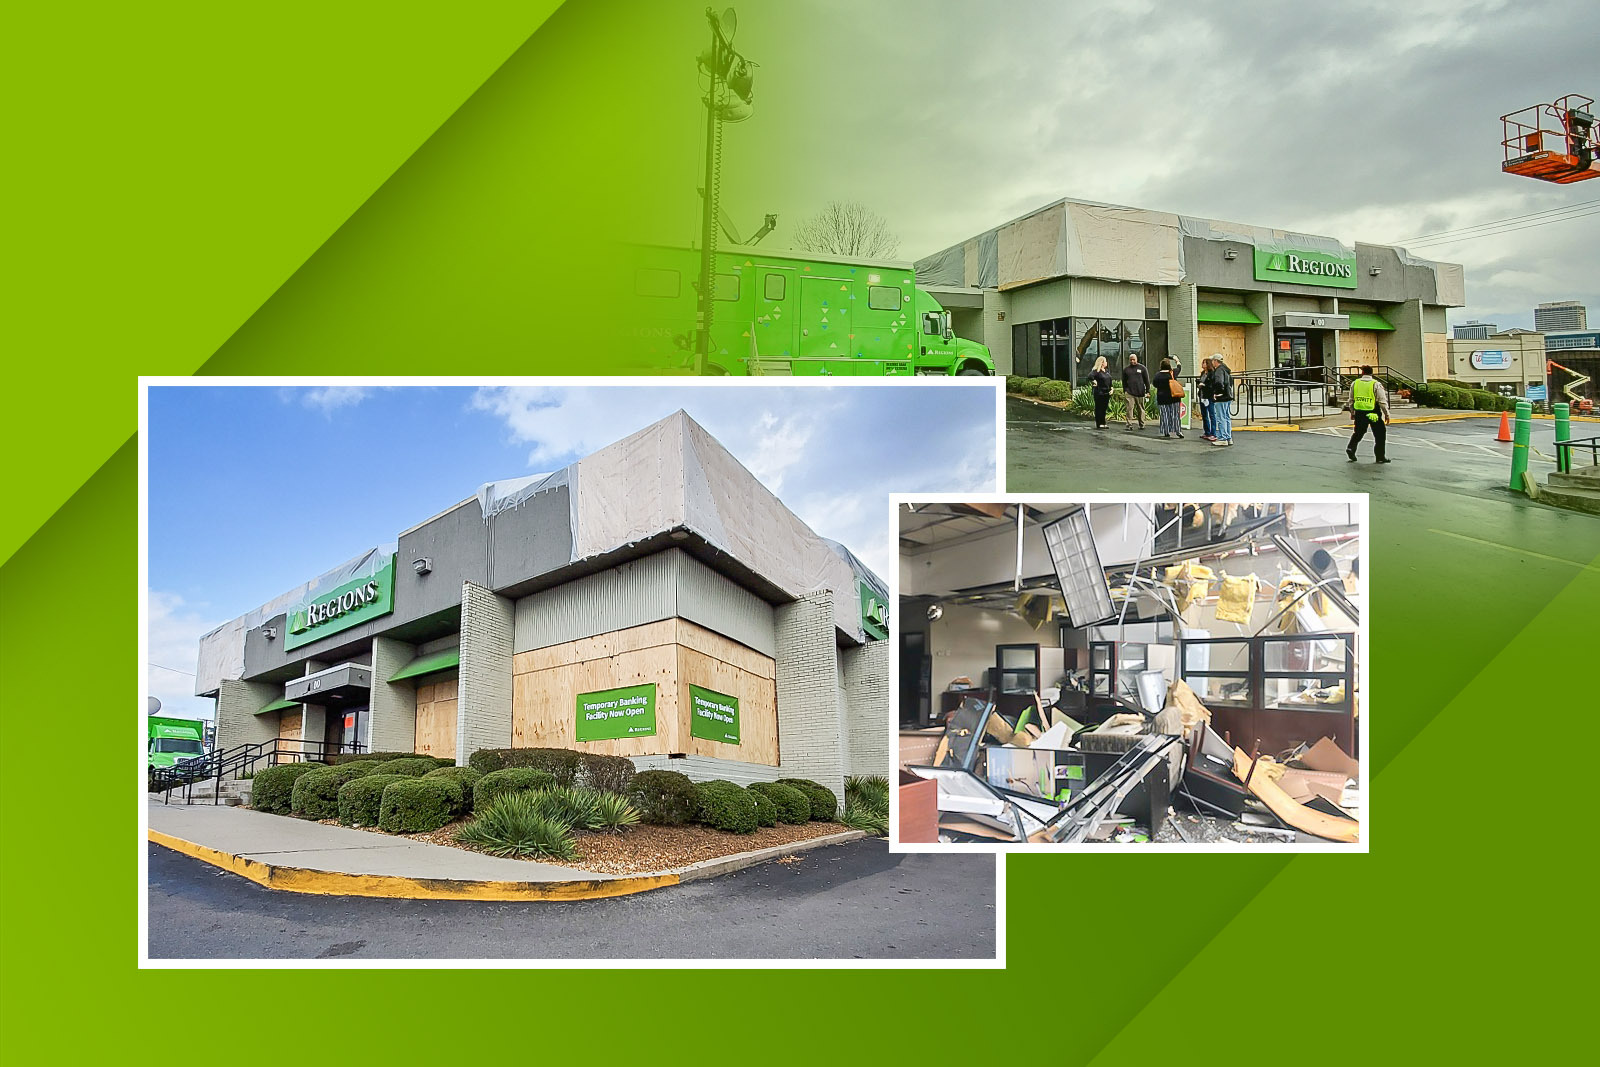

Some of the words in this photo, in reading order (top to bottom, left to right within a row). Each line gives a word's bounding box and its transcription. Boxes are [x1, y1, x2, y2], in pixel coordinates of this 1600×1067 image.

[1289, 254, 1352, 278] REGIONS
[306, 580, 375, 627] REGIONS
[583, 700, 618, 711] Temporary
[619, 696, 648, 706] Banking
[694, 696, 718, 711] Temporary
[718, 704, 735, 716] Banking
[585, 711, 608, 720] Facility
[609, 710, 625, 718] Now
[625, 708, 645, 717] Open
[697, 708, 713, 720] Facility
